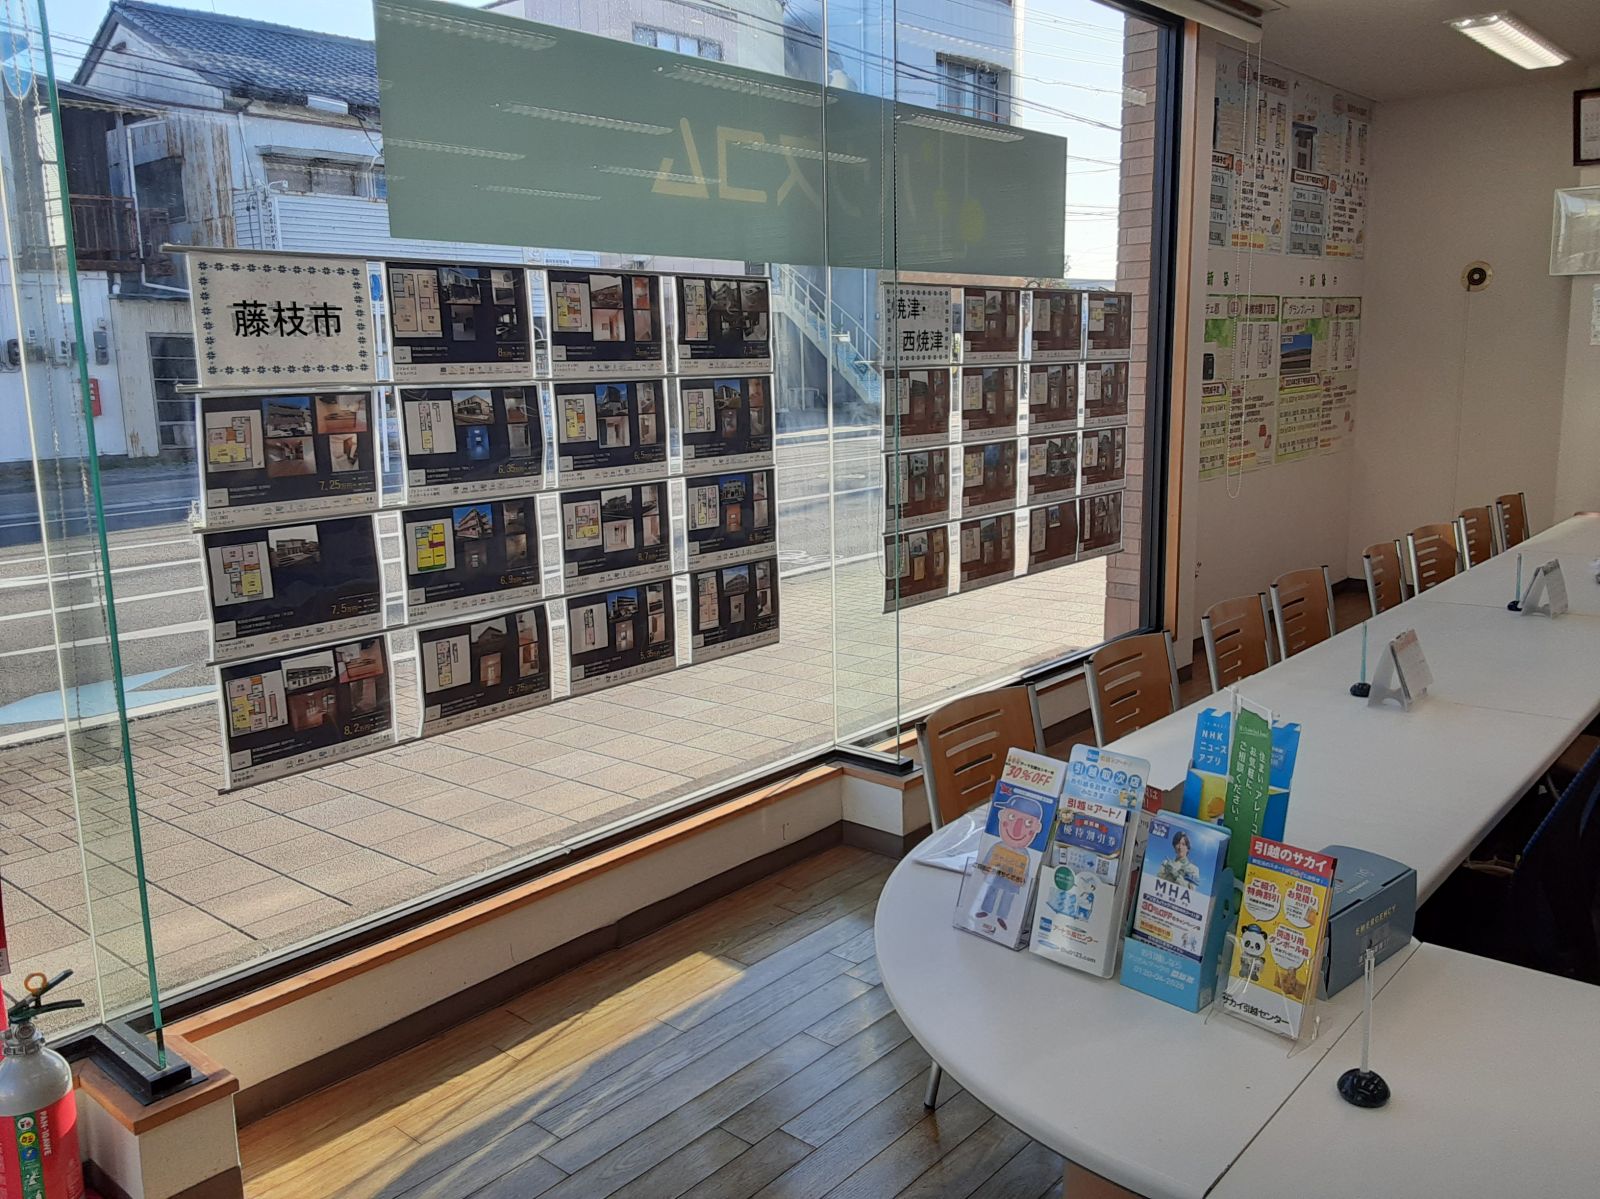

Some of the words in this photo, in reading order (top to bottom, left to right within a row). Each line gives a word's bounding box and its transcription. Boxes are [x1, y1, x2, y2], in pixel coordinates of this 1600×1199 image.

[233, 300, 343, 338] 藤枝市
[902, 330, 944, 352] 西焼津
[1202, 729, 1223, 741] NHK
[1199, 741, 1227, 754] ニュース
[1198, 753, 1221, 765] アプリ
[1006, 765, 1053, 786] 30%OFF
[1254, 840, 1328, 873] 引越のサカイ
[1155, 879, 1191, 903] MHA
[1252, 879, 1277, 893] ご紹介
